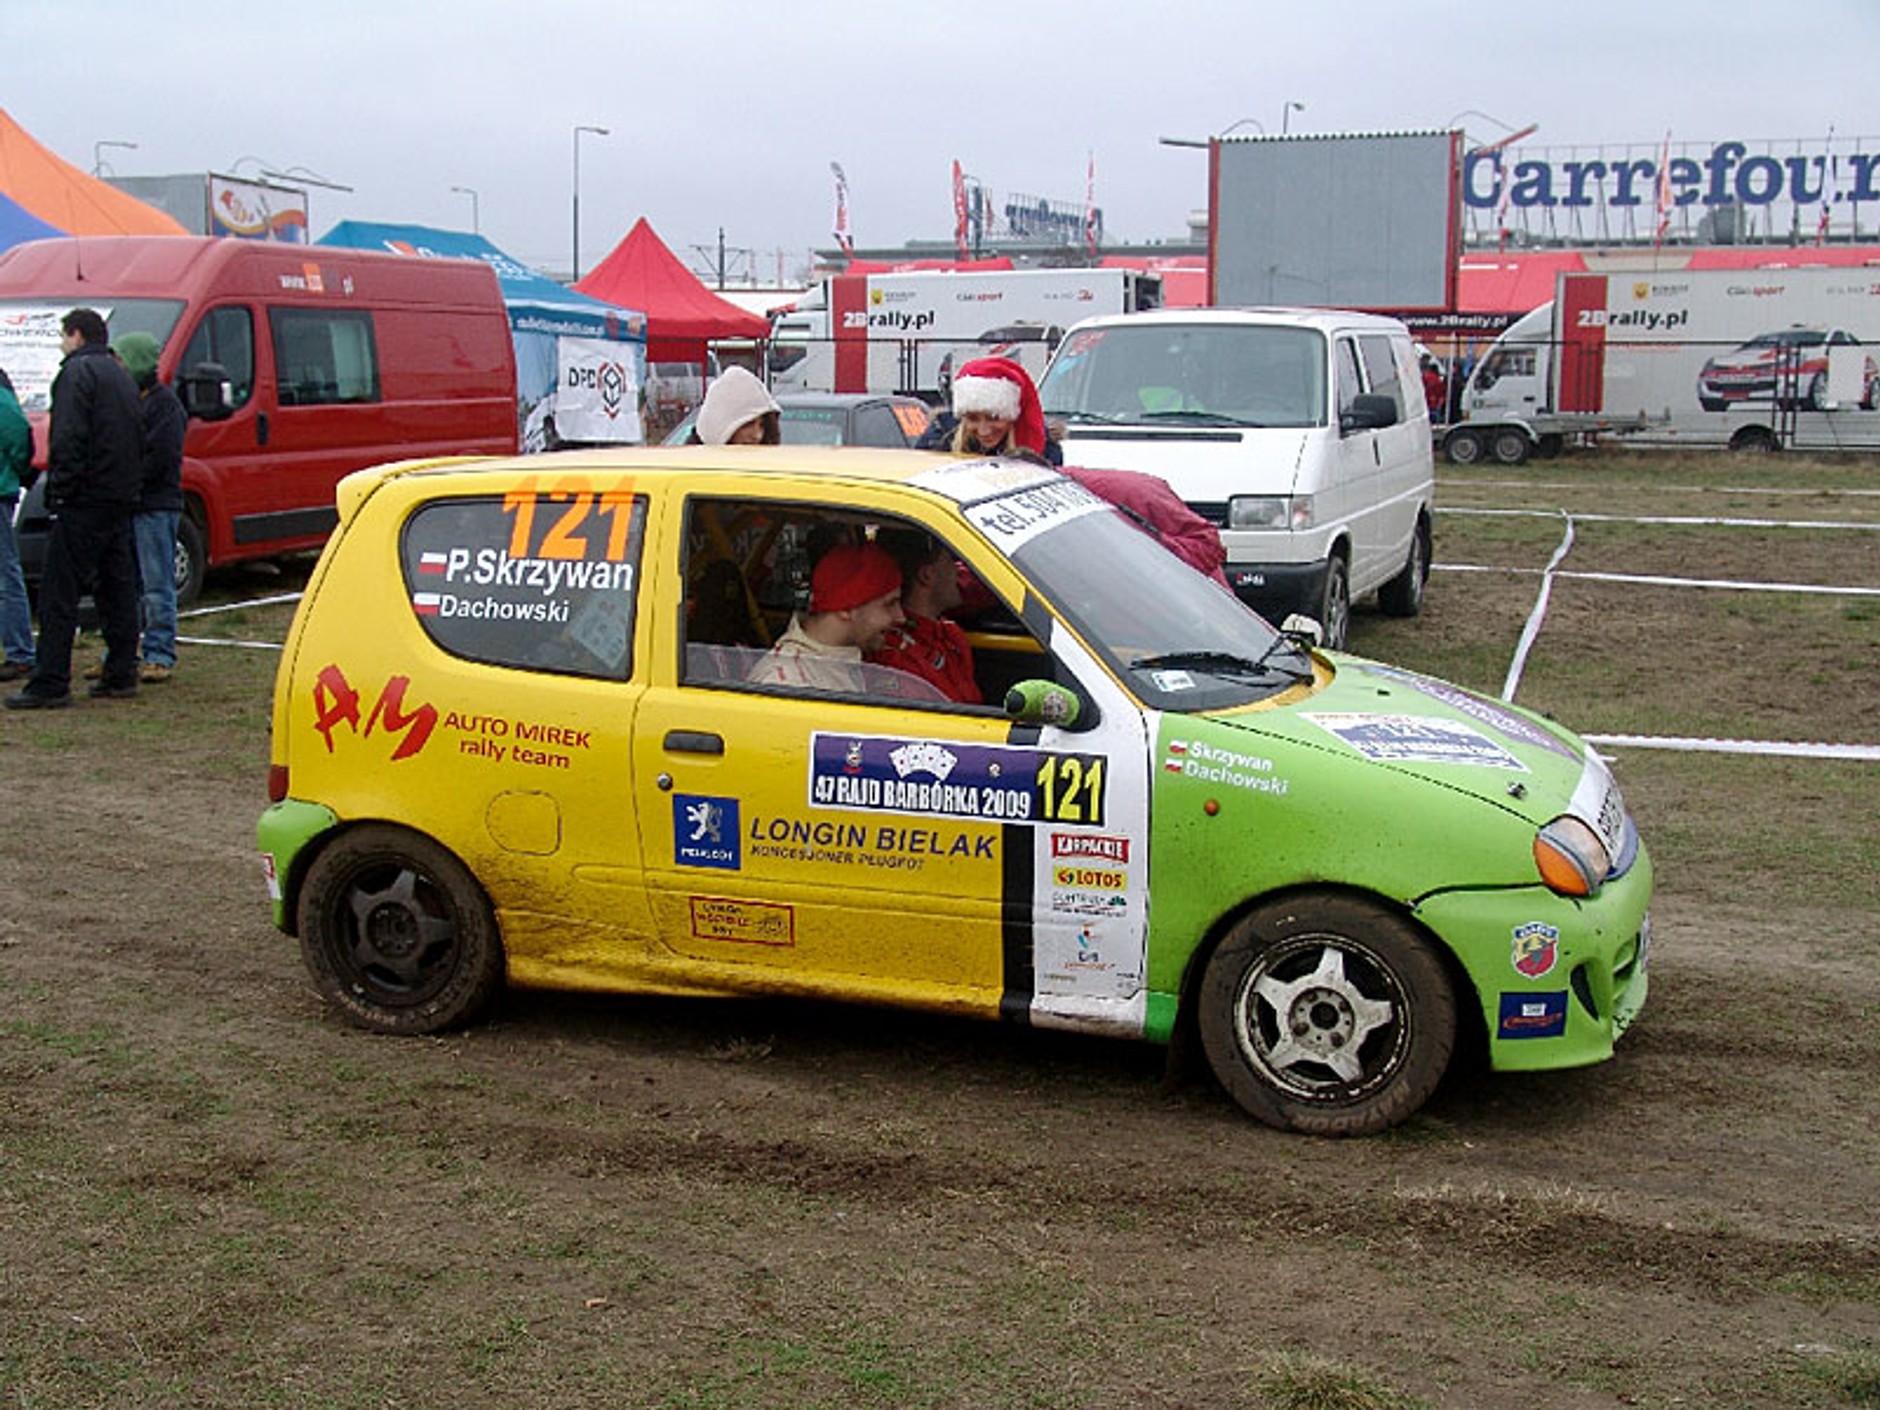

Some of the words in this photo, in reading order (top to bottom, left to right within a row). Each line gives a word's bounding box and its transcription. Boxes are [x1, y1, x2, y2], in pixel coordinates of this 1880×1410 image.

[1464, 141, 1880, 207] Carrefour
[503, 475, 637, 561] 121
[446, 549, 634, 595] P.Skrzywan
[440, 595, 571, 622] Dachowski
[444, 712, 508, 736] AUTO
[515, 721, 591, 749] MIREK
[460, 738, 506, 762] rally
[512, 745, 570, 768] team
[1190, 741, 1273, 771] Skrzywan
[1036, 755, 1103, 822] 121
[1185, 760, 1289, 794] Dachowski
[837, 776, 880, 806] RAJD
[883, 778, 979, 816] BARBÓRKA
[982, 787, 1031, 819] 2009
[751, 818, 867, 848] LONGIN
[877, 827, 997, 859] BIELAK
[1076, 868, 1122, 888] LOTOS
